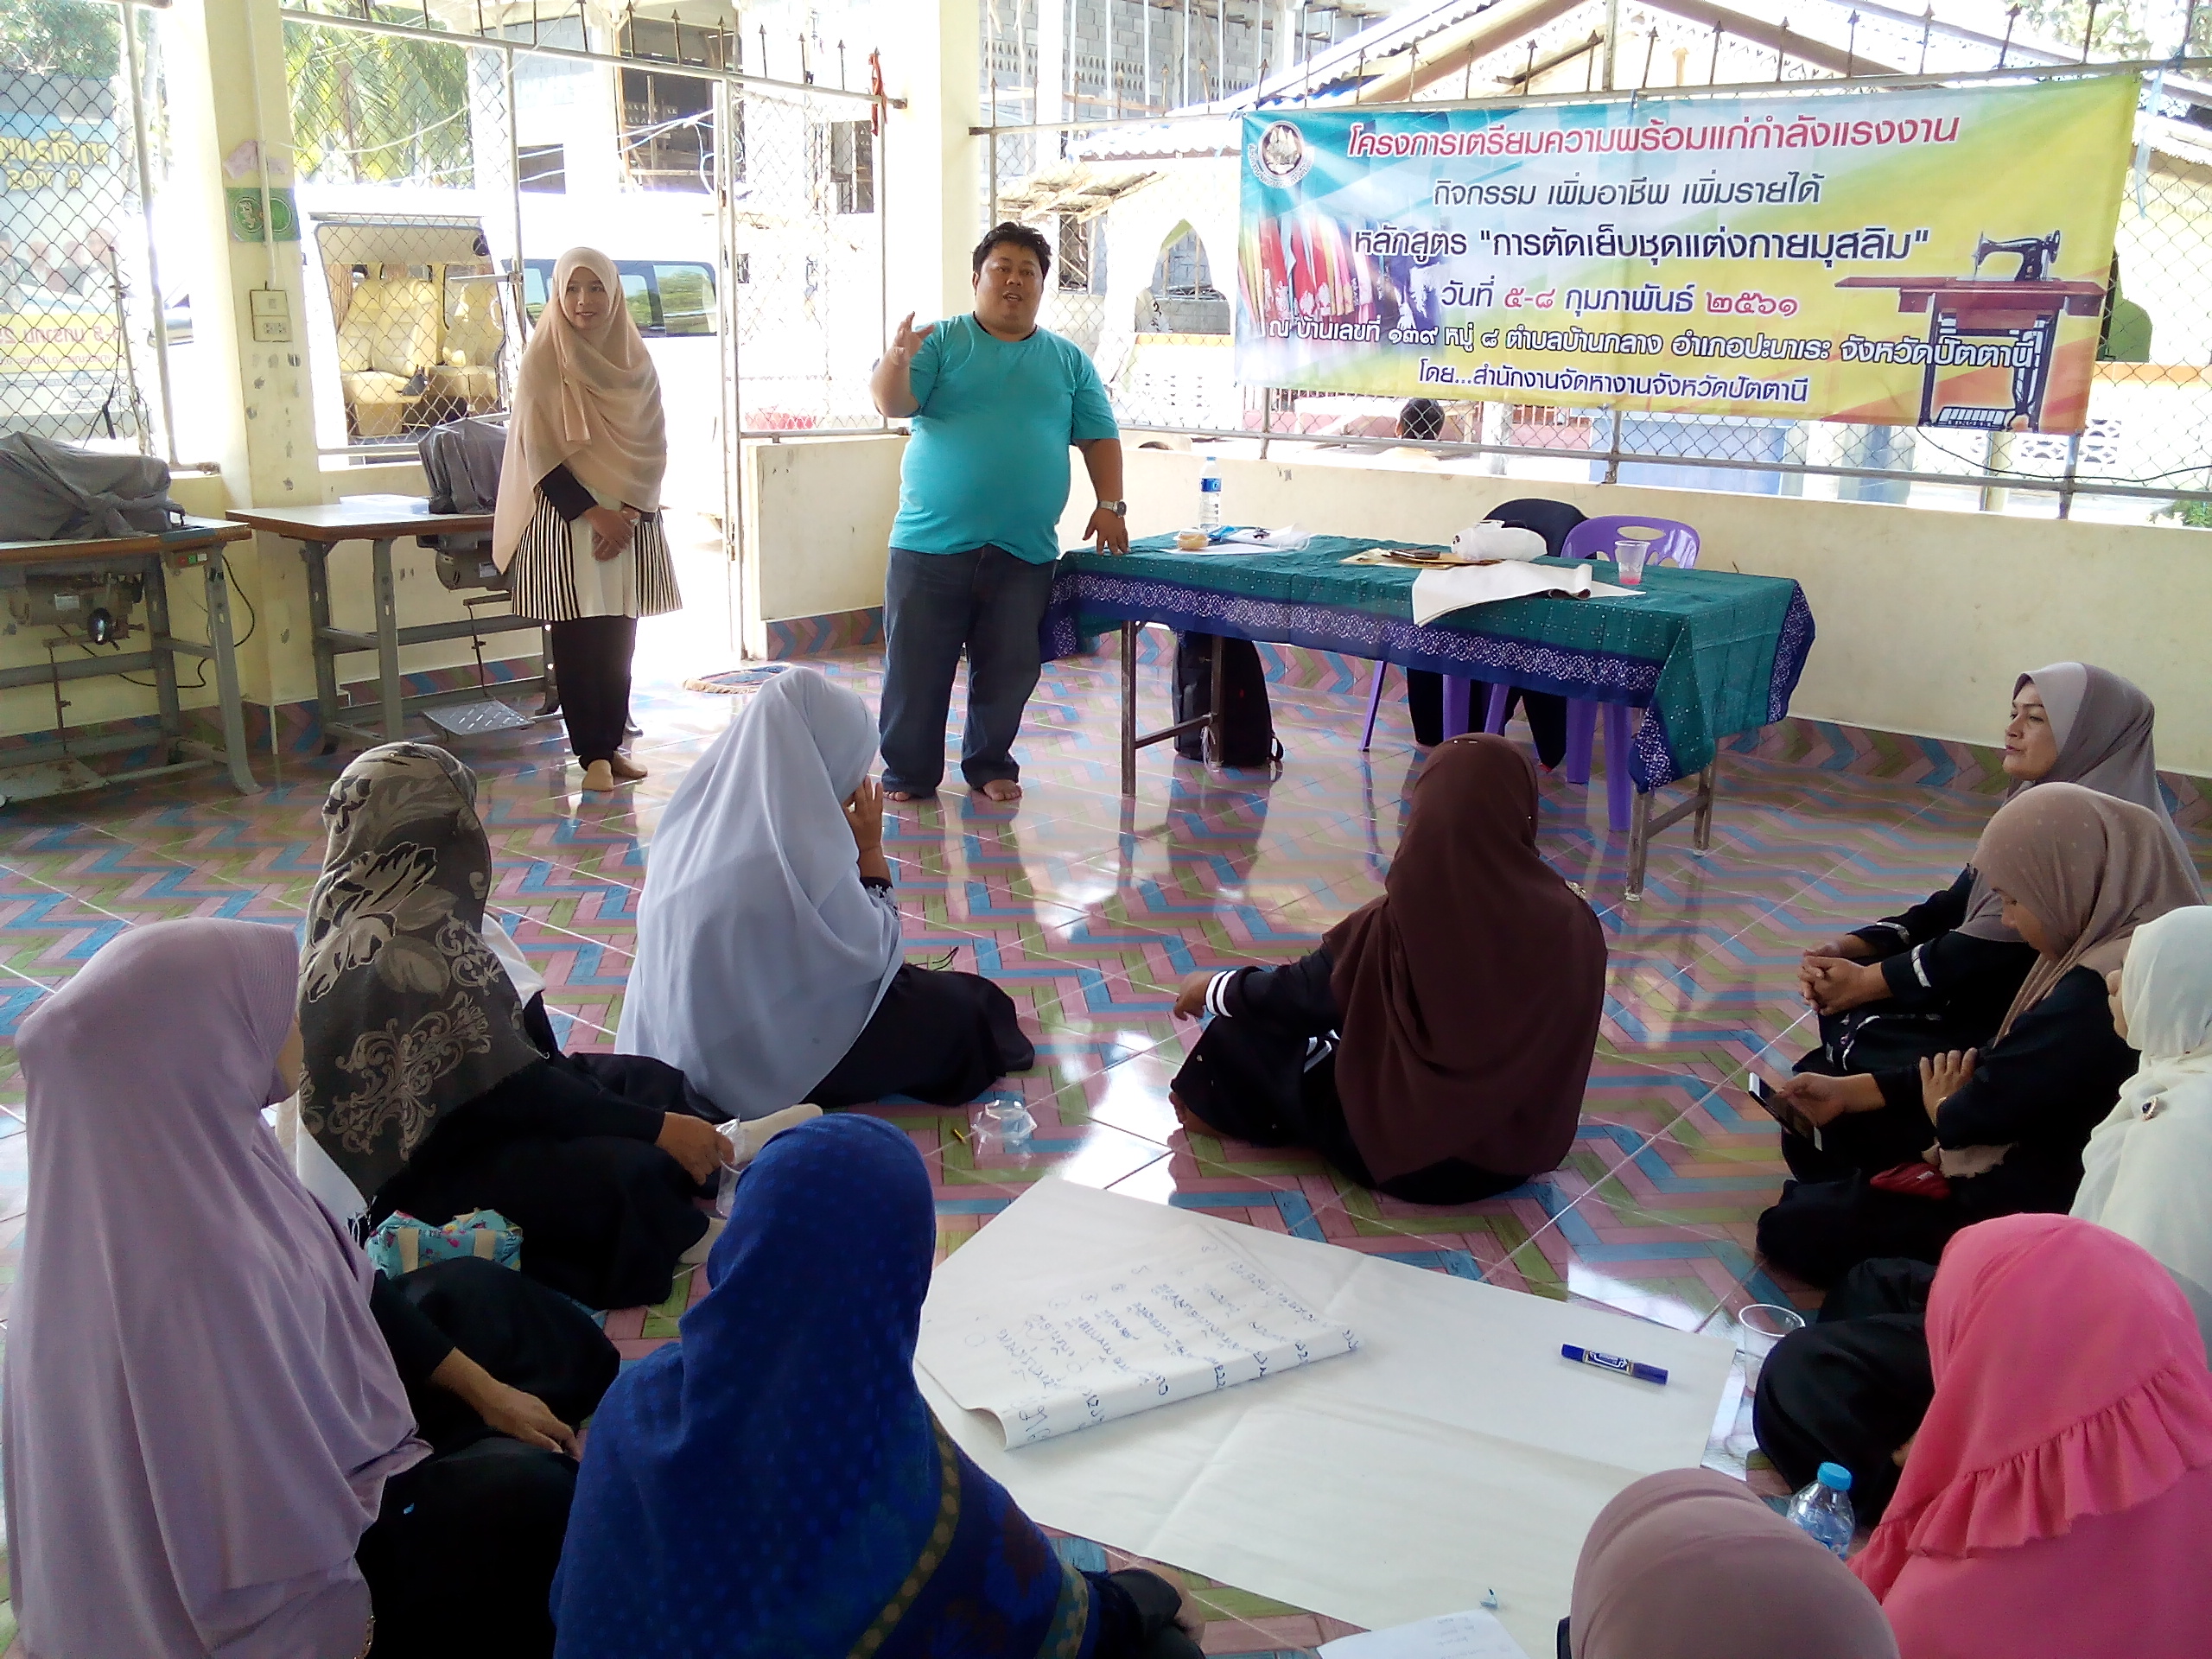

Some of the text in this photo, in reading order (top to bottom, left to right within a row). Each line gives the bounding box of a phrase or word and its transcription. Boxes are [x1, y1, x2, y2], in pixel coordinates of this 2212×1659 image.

[1347, 115, 1961, 157] โครงการเตรียมความพร้อมแก่กำลังแรงงาน
[1433, 169, 1825, 207] กิจกรรม เพิ่มอาชีพ เพิ่มรายได้
[1354, 224, 1929, 268] หลักสูตร "การตัดเย็บชุดแต่งกายมุสลิม"
[1440, 275, 1800, 320] วันที่ ๕-๘ กุมภาพันธ์ ๒๕๖๑
[1268, 313, 2036, 370] ณ บ้านเลขที่ ๑๓๙ หมู่ ๘ ตำบลบ้านกลาง อำเภอปะนาเระ จังหวัดปัตตานี
[1418, 358, 1809, 403] โดย...สำนักงานจัดหางานจังหวัดปัตตานี
